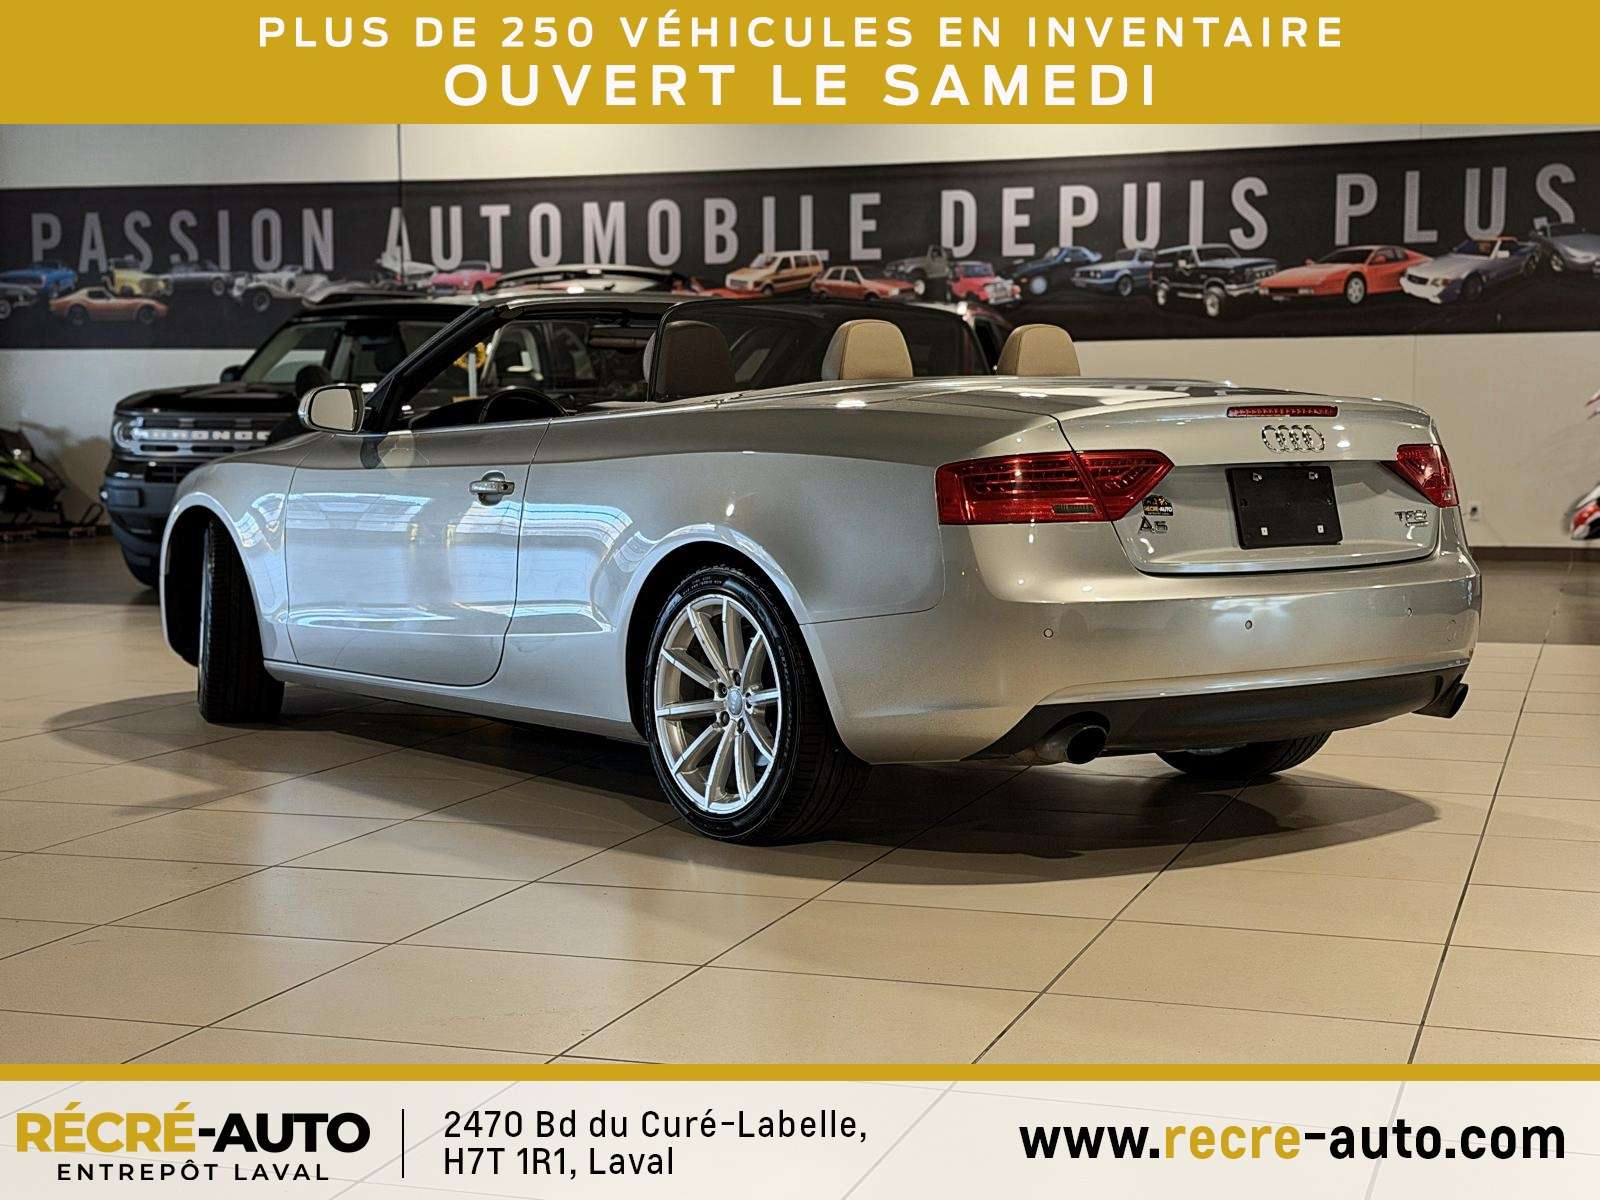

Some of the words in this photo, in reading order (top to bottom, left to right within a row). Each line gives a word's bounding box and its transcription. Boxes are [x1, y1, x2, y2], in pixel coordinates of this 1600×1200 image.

[30, 207, 335, 273] PASSION
[388, 192, 884, 271] AUTOMOBILE
[941, 176, 1269, 259] DEPUIS
[1334, 163, 1576, 247] PLUS
